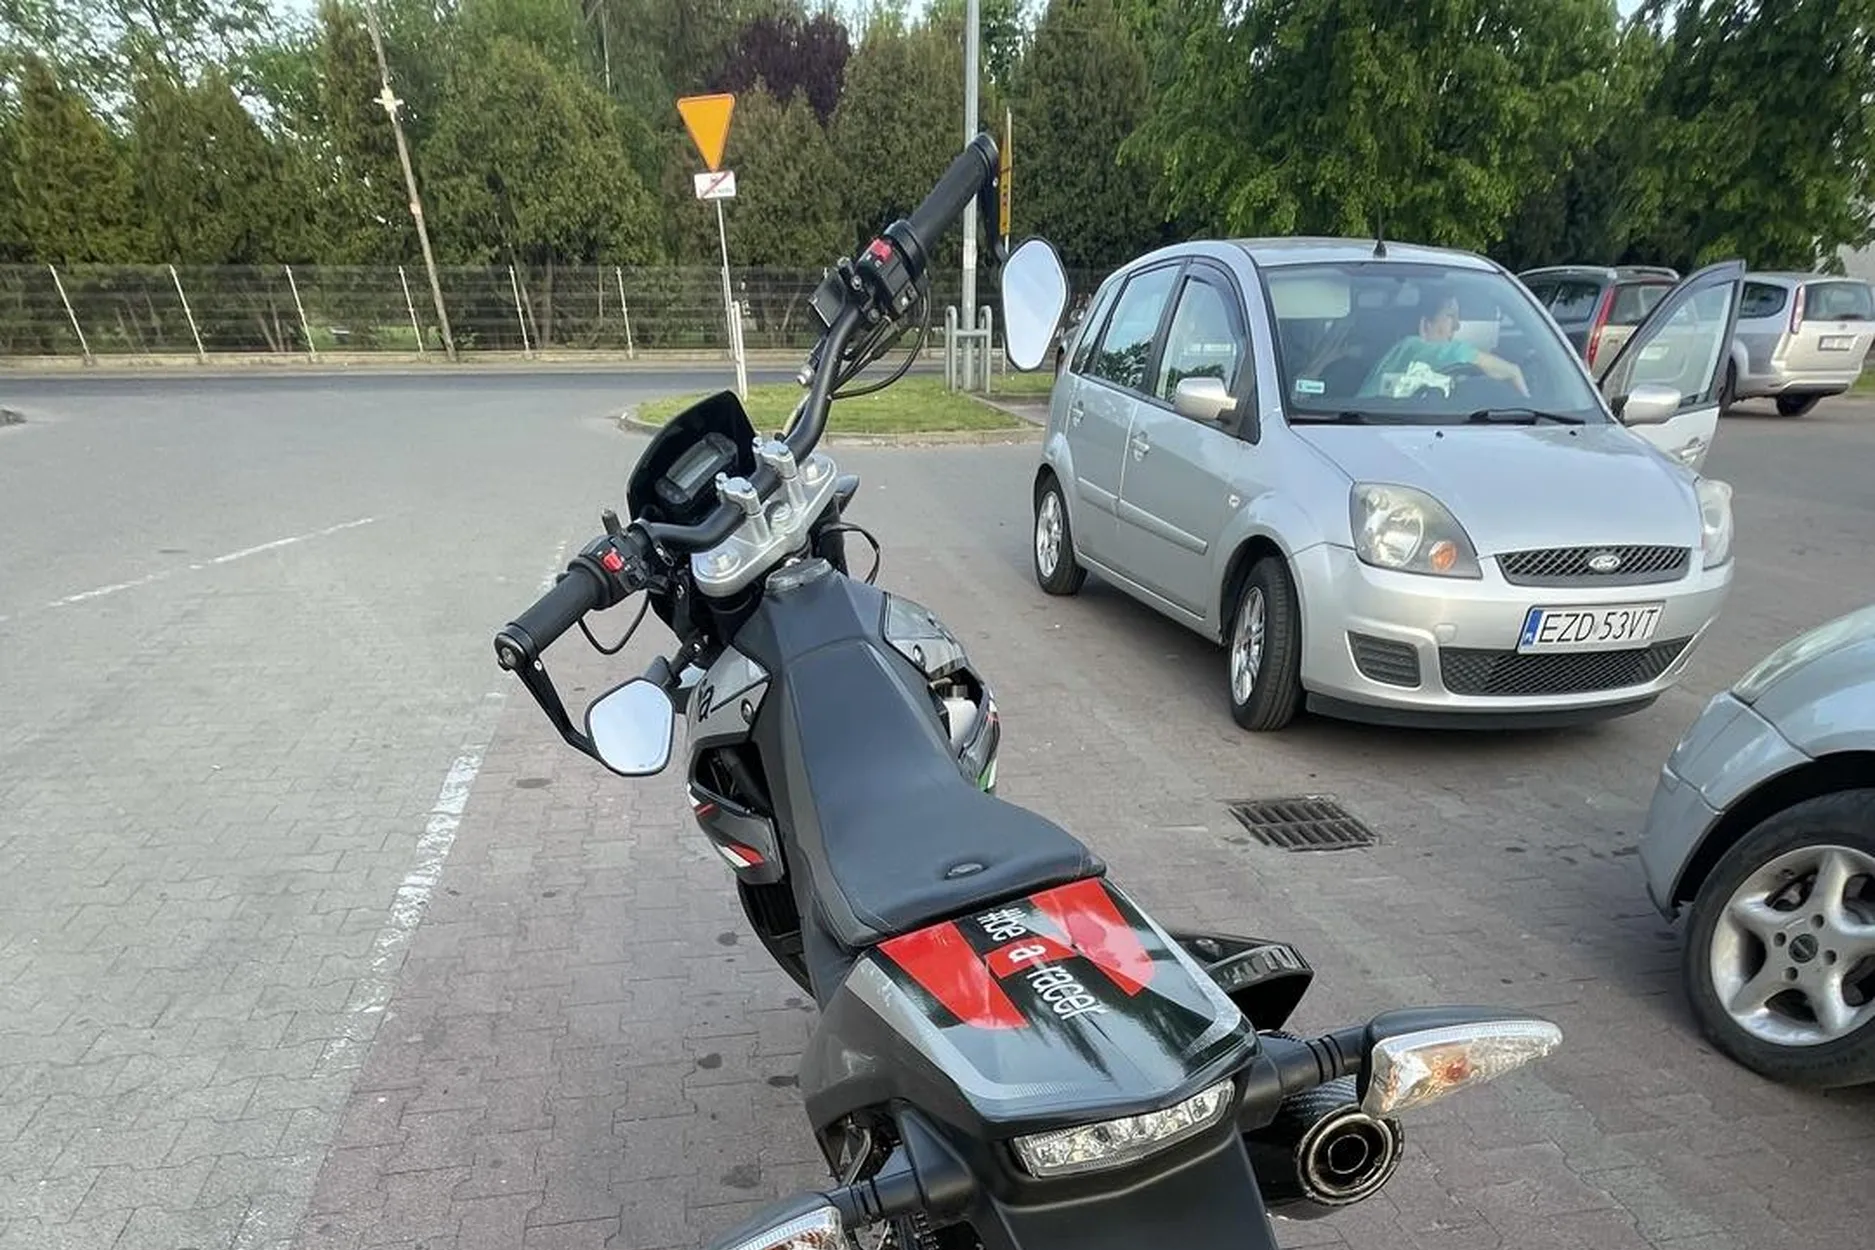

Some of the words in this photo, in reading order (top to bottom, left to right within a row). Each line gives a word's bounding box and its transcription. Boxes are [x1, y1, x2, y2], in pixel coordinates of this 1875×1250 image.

[1537, 612, 1596, 643] EZD
[1598, 608, 1658, 640] 53VT
[976, 907, 1027, 942] #be
[1007, 944, 1047, 963] a
[1026, 965, 1109, 1020] racer
